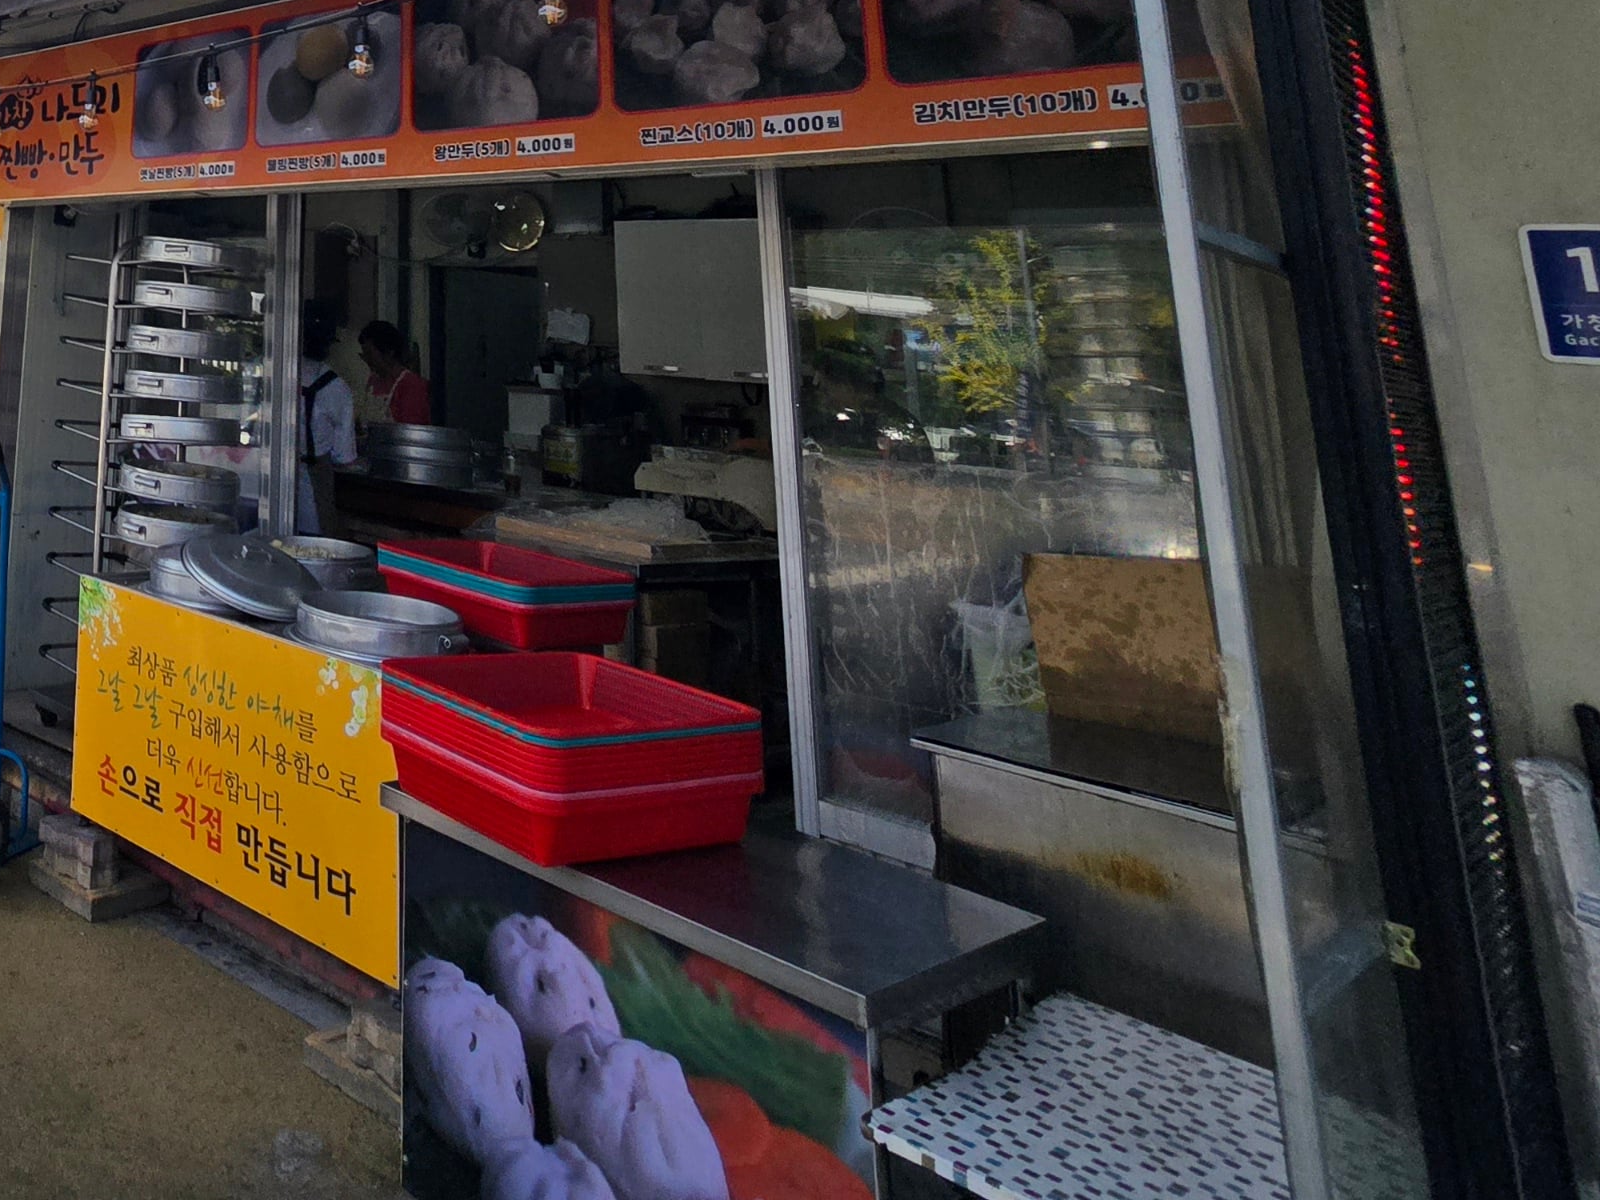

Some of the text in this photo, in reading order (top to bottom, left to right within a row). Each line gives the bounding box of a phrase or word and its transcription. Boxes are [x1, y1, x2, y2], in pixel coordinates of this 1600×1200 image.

[41, 81, 120, 123] 나드리
[914, 87, 1097, 124] 김치만두(10개)
[433, 133, 575, 162] 왕만두(5개) 4.000원
[639, 113, 841, 146] 찐교스(10개) 4.000원
[198, 163, 235, 176] 4.000원
[340, 151, 386, 168] 4.000원
[127, 645, 318, 744] 최상품 싱싱한 야채를
[97, 669, 361, 804] 그날 그날 구입해서 사용함으로
[146, 738, 288, 827] 더욱 신선합니다.
[97, 754, 357, 917] 손으로 직접 만듭니다
